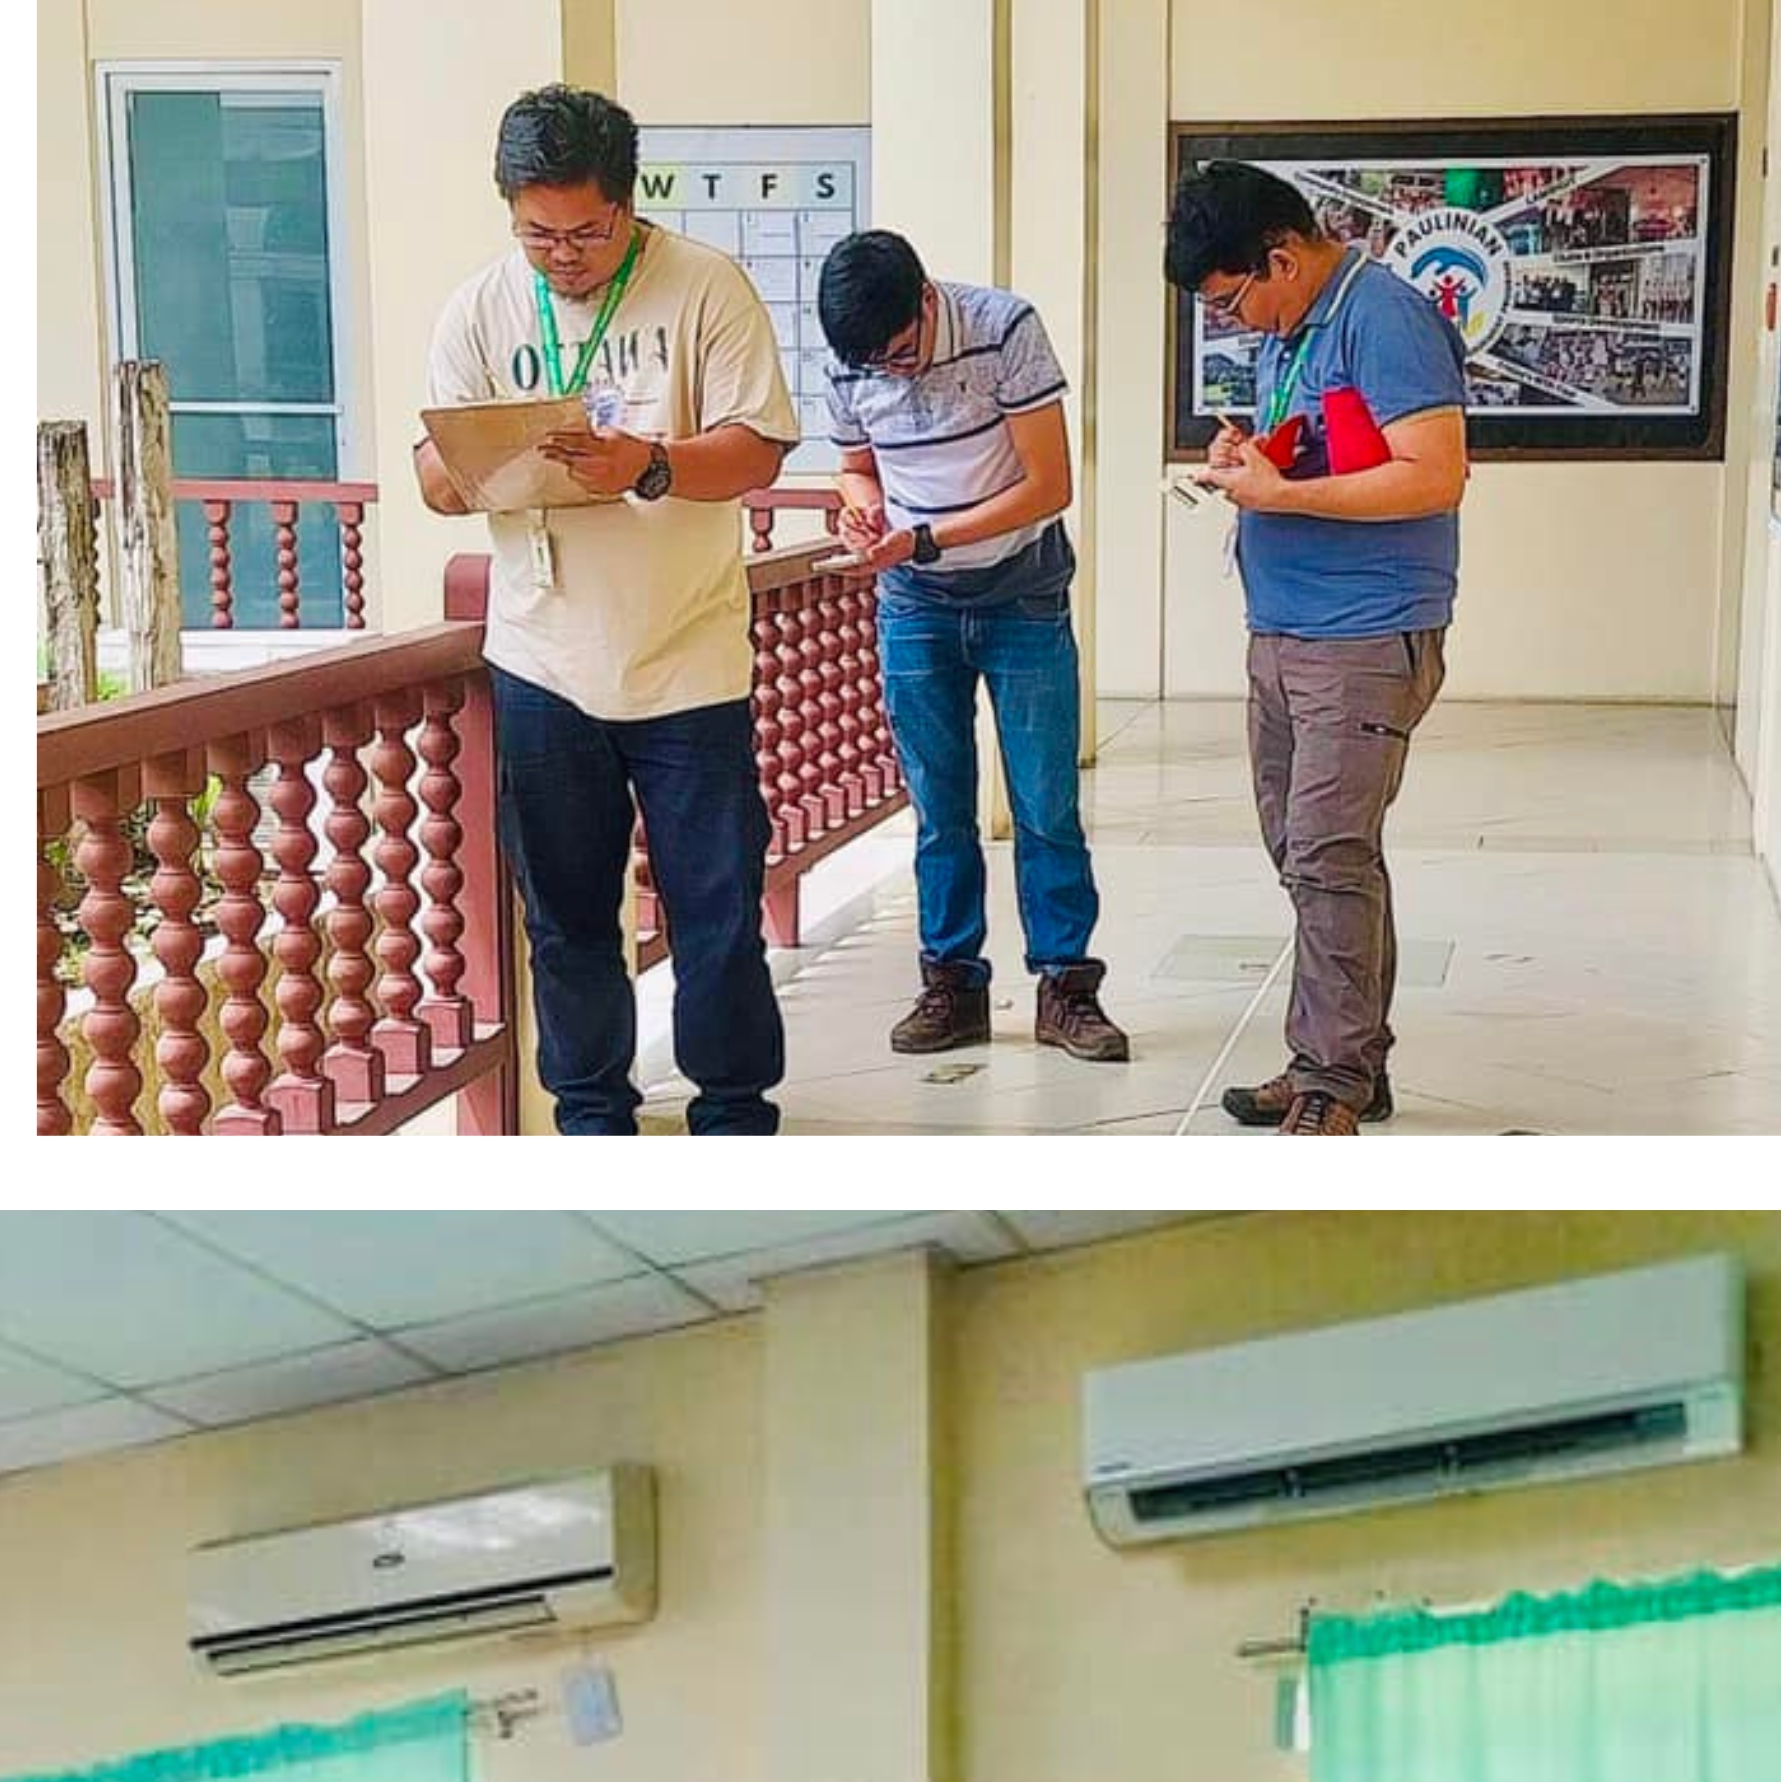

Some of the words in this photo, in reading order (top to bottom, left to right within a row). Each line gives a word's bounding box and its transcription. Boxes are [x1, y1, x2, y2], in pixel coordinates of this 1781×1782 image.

[641, 174, 675, 199] W
[703, 174, 721, 199] T
[761, 174, 778, 199] F
[816, 173, 835, 199] S
[1394, 212, 1503, 257] PAULINIAN
